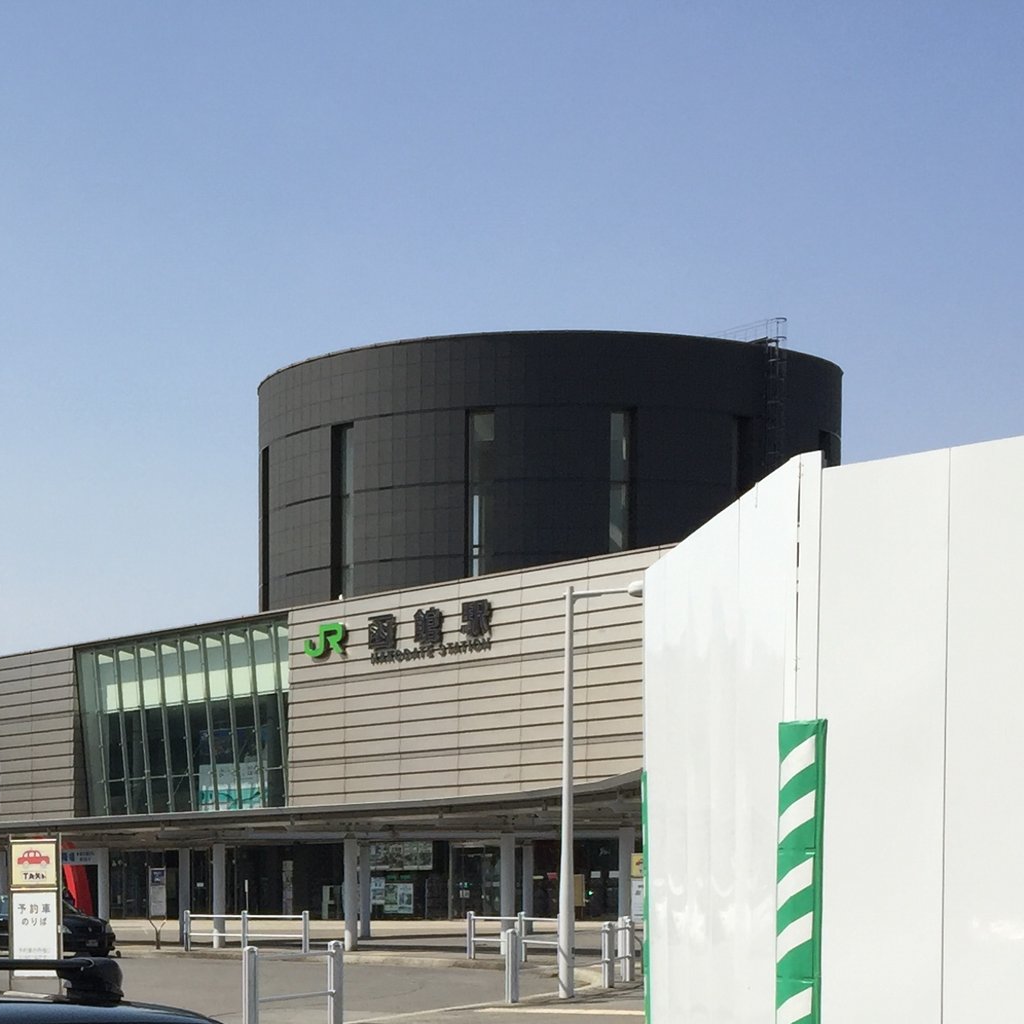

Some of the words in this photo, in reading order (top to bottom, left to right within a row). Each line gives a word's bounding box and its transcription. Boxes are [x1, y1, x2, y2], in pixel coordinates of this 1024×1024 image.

[368, 599, 492, 650] 函館駅
[304, 622, 345, 657] JR
[439, 638, 491, 657] STATION
[23, 872, 46, 880] TAXI
[17, 903, 51, 915] 予約車
[21, 917, 47, 927] のりば
